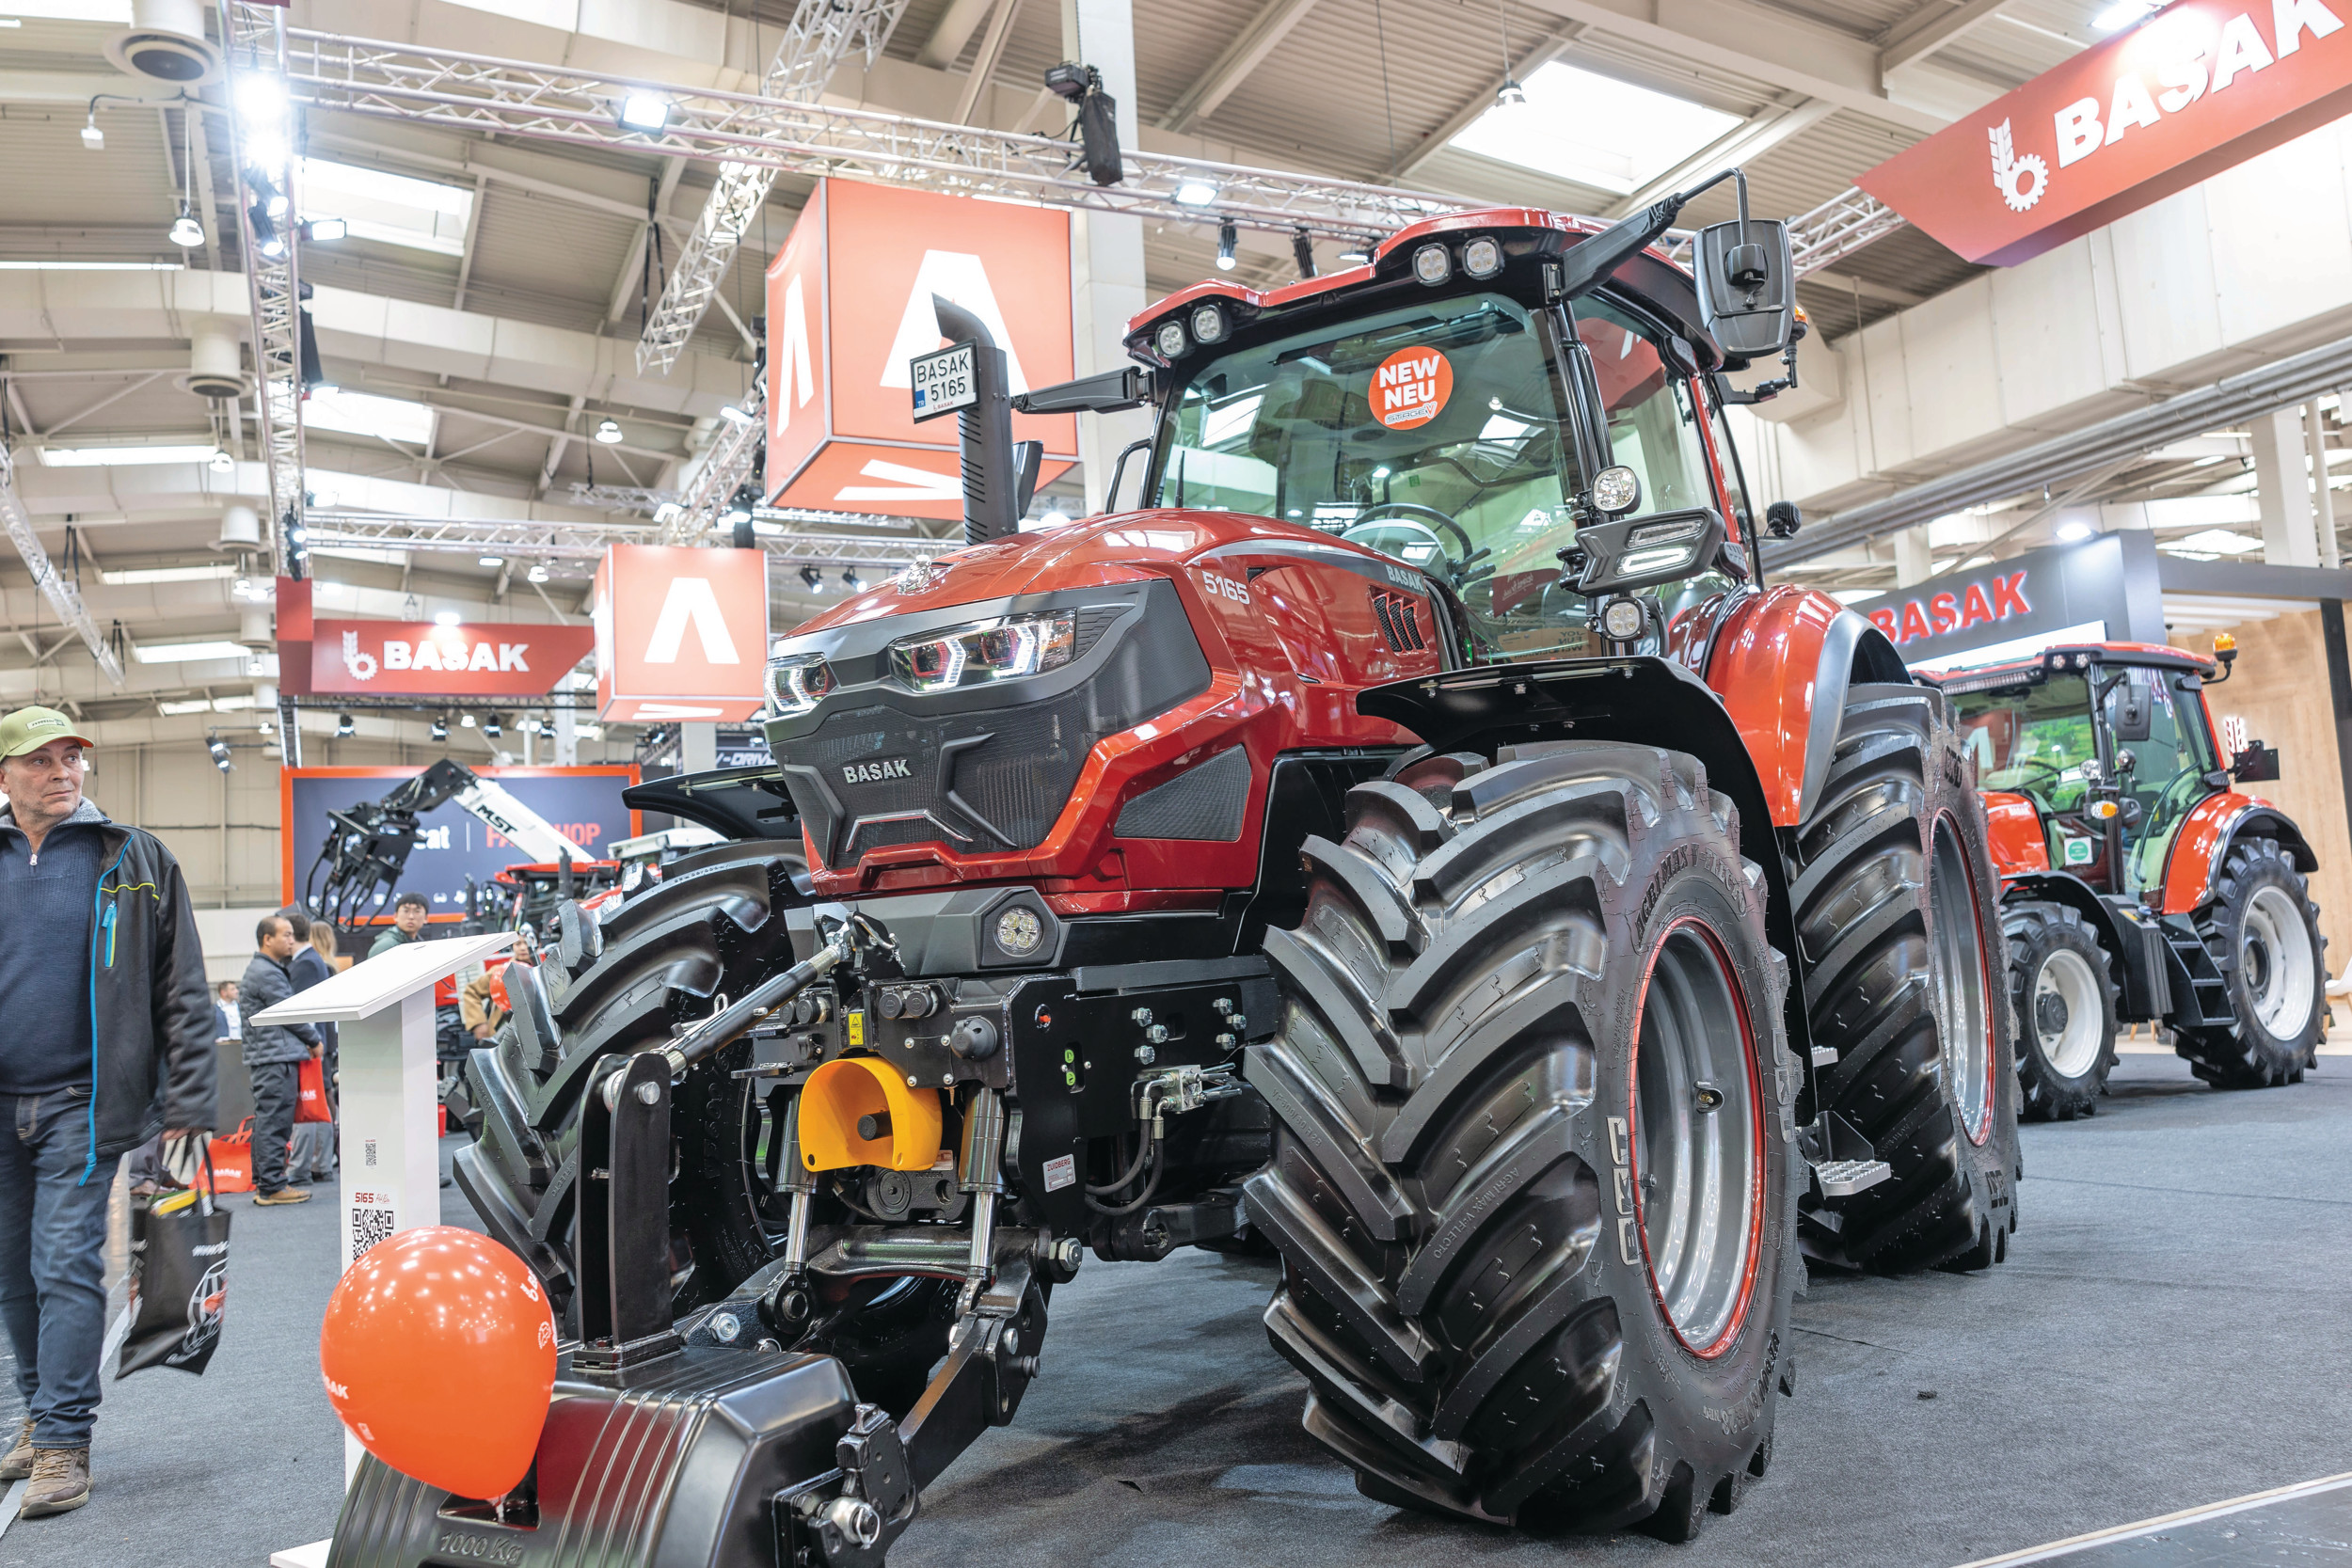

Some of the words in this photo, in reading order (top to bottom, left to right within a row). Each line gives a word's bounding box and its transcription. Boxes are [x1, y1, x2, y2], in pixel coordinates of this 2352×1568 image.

[2053, 0, 2346, 168] BASAK
[917, 352, 969, 384] BASAK
[1379, 355, 1440, 388] NEW
[930, 376, 966, 402] 5165
[1384, 379, 1436, 410] NEU
[937, 401, 954, 409] BASAK
[1201, 570, 1250, 605] 5165
[1385, 564, 1425, 592] BASAK
[1868, 570, 2032, 645] BASAK
[383, 641, 530, 672] BASAK
[843, 759, 912, 784] BASAK
[476, 804, 517, 834] MST
[1046, 1157, 1072, 1172] ZUIDBERG
[355, 1192, 374, 1203] 5165
[1606, 1116, 1641, 1266] BKT
[440, 1531, 488, 1558] 1000
